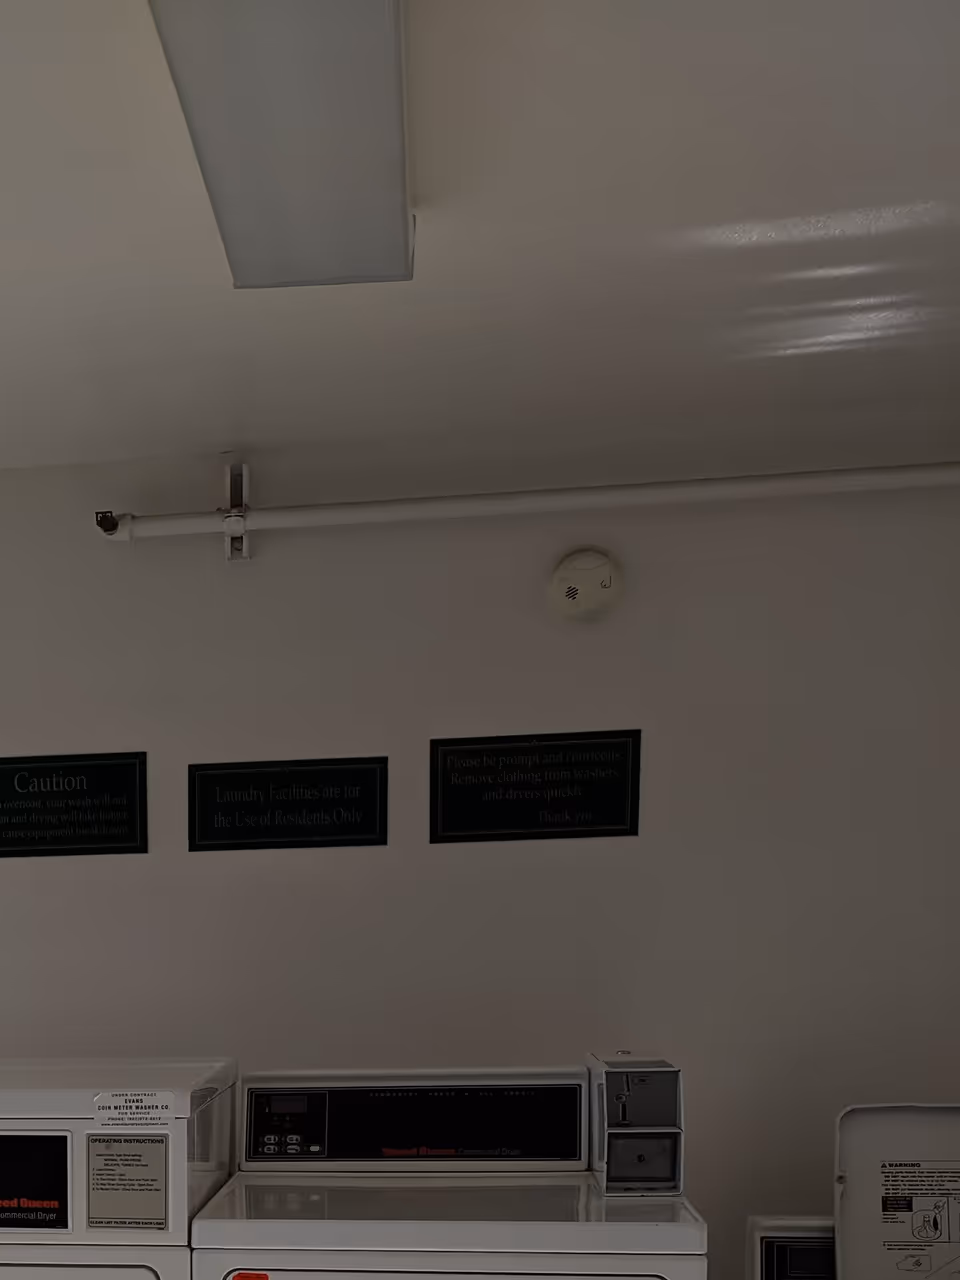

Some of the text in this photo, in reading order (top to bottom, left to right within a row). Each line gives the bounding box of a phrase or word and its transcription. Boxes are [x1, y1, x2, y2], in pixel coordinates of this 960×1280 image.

[499, 752, 539, 769] prompt
[14, 771, 87, 793] Caution
[451, 773, 495, 786] Remove
[497, 769, 541, 785] clothing
[216, 784, 264, 807] Laundry
[270, 782, 321, 801] Facilities
[215, 805, 363, 828] the Use of Residents Only
[20, 1197, 59, 1208] Queen
[37, 1211, 57, 1221] Dryer
